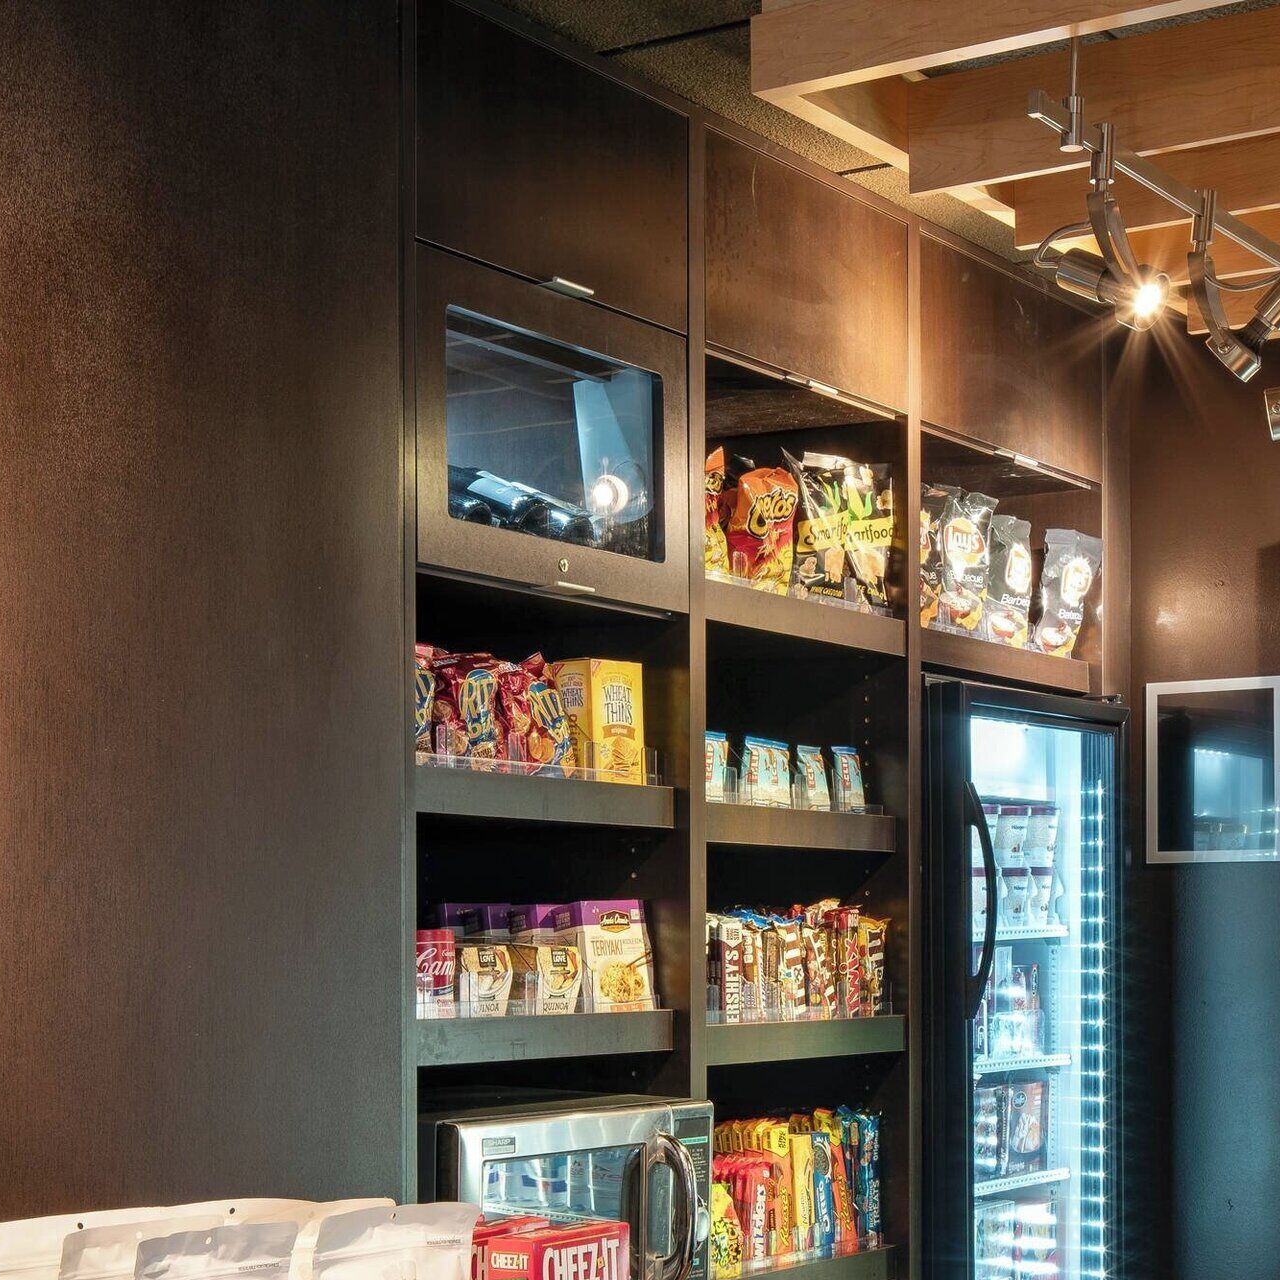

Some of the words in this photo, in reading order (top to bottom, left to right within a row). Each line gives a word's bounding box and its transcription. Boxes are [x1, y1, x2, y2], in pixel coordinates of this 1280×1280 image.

[561, 686, 583, 698] WHEAT
[602, 685, 632, 703] WHEAT
[590, 938, 623, 957] TERIYAKI
[480, 955, 495, 964] LOVE
[552, 955, 566, 964] LOVE
[725, 949, 740, 1023] ERSHEY'S
[543, 1003, 569, 1012] QUINOA
[818, 1181, 830, 1232] OREO
[872, 1180, 880, 1225] TREATS
